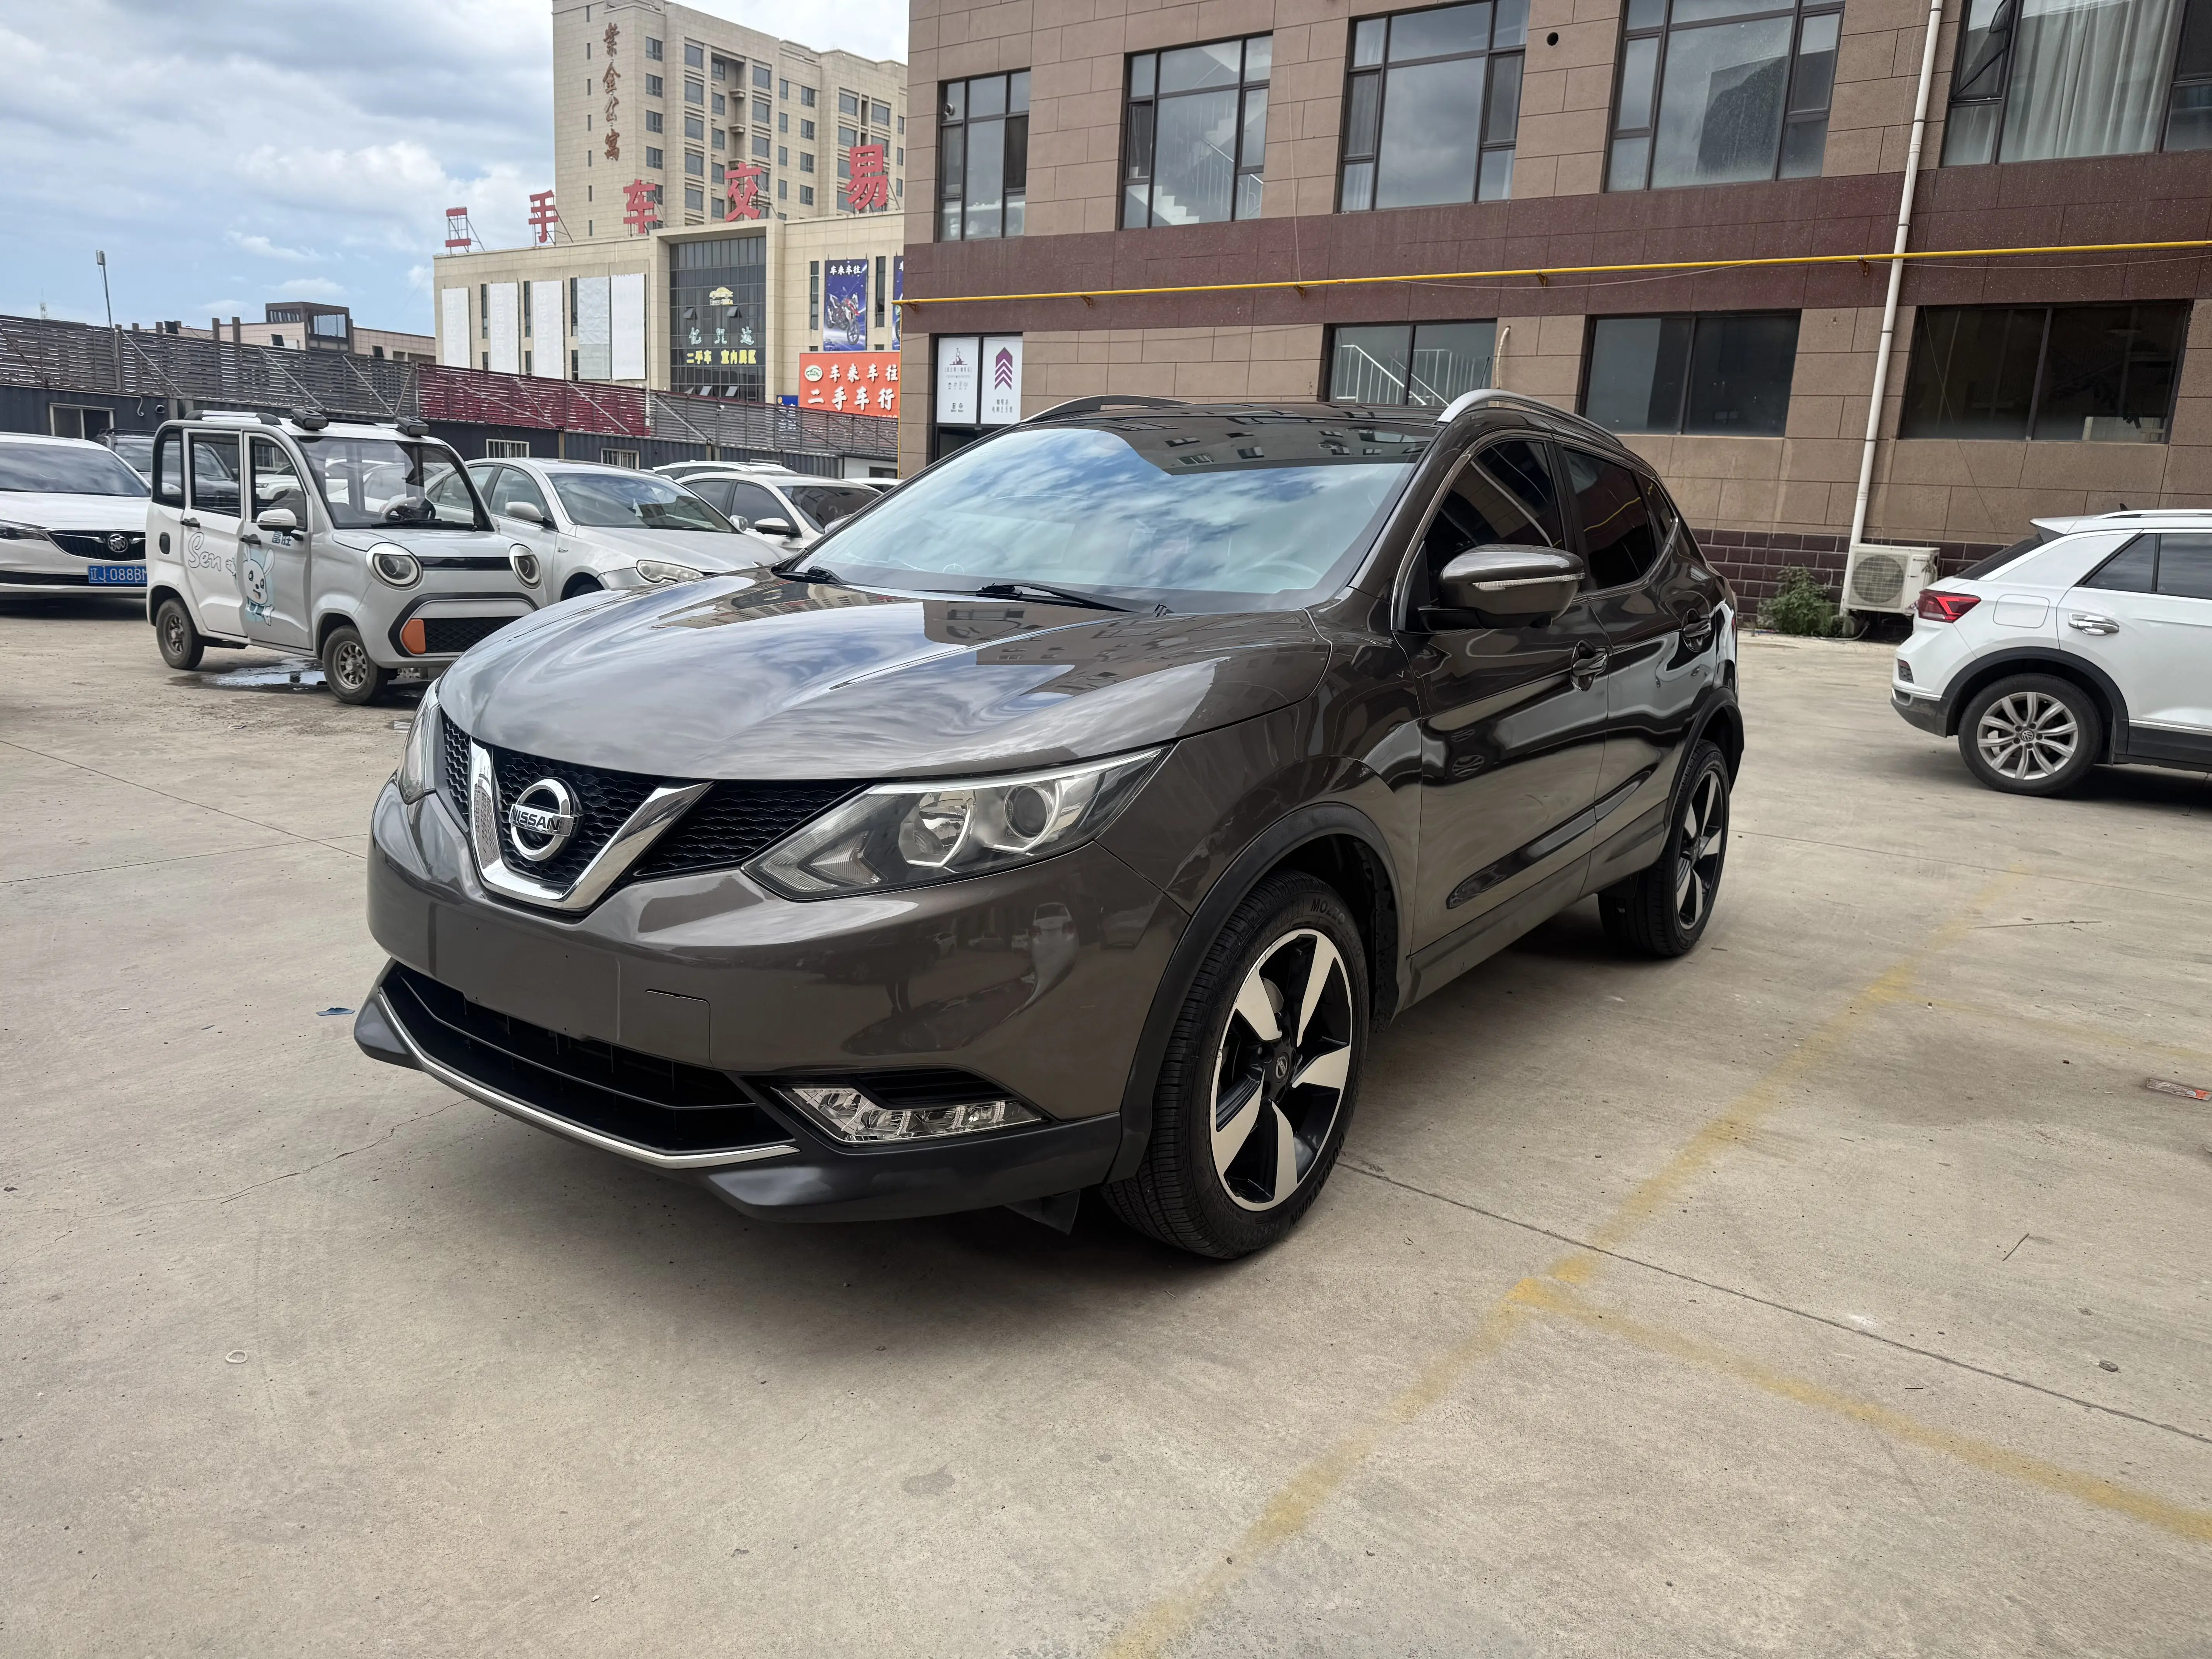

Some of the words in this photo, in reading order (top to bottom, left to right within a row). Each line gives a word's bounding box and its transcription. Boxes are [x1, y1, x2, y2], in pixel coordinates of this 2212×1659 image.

[445, 144, 888, 247] 二手车交易
[830, 265, 861, 275] 车来车往
[829, 363, 898, 383] 车来车往
[807, 386, 895, 410] 二手车行
[188, 532, 221, 572] Sen
[510, 807, 560, 831] NISSAN
